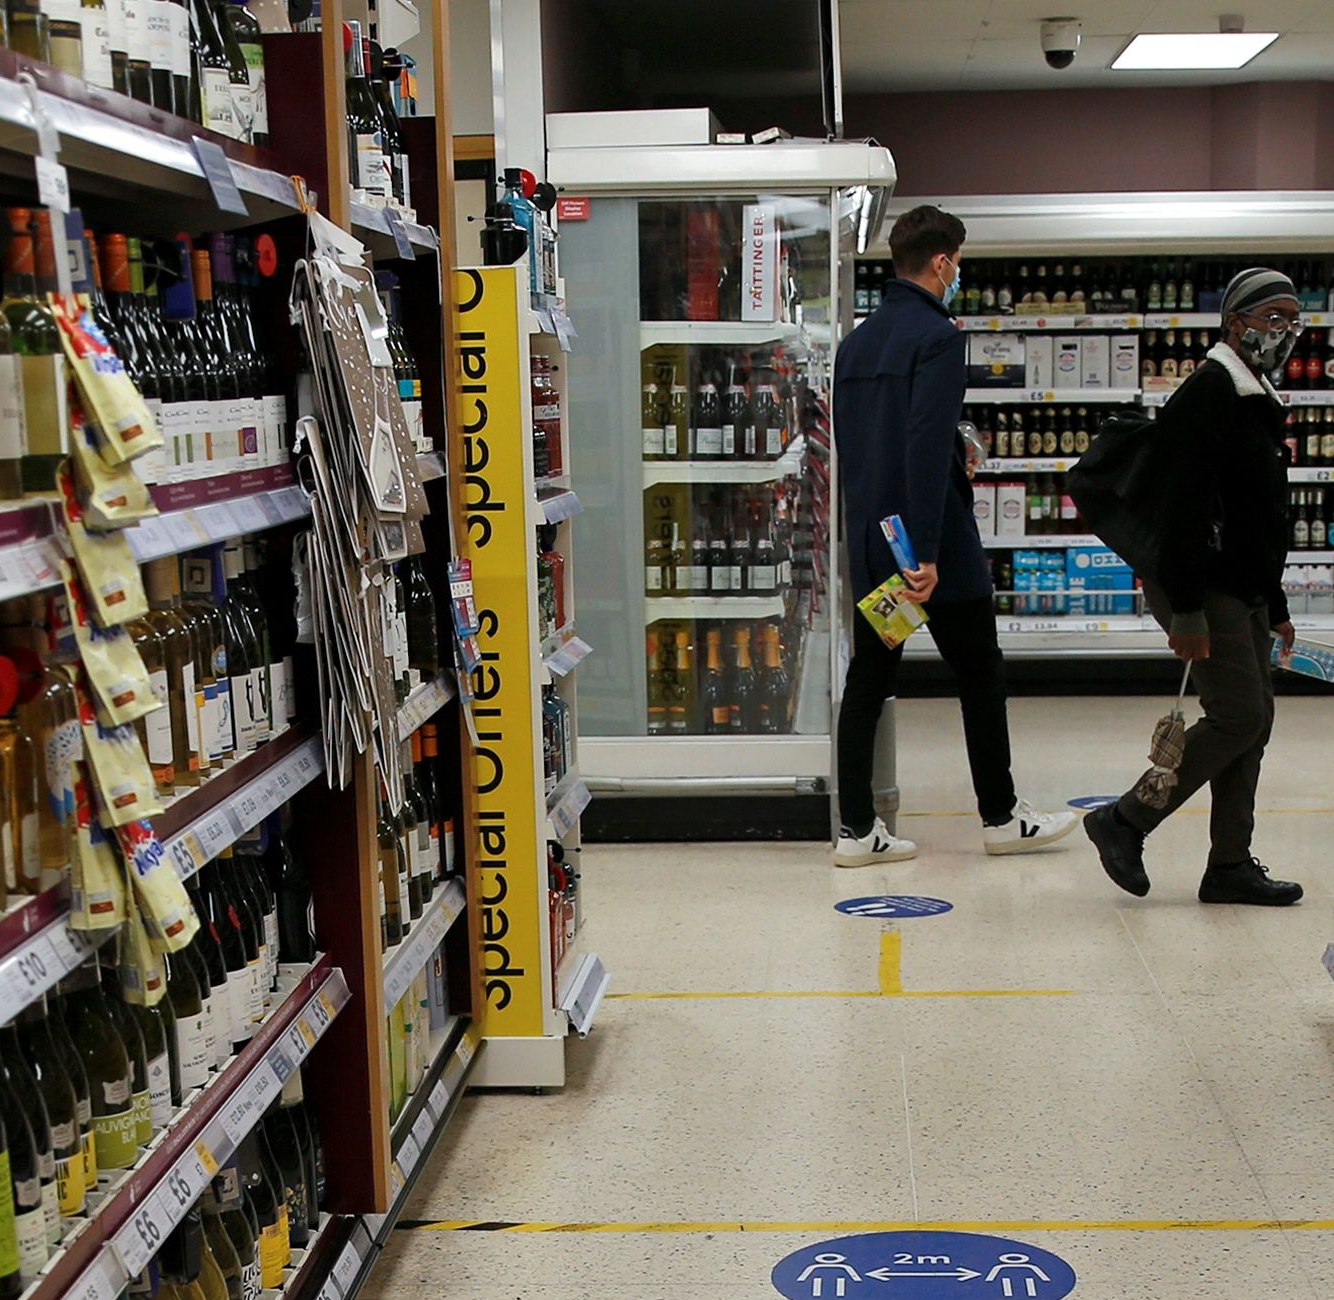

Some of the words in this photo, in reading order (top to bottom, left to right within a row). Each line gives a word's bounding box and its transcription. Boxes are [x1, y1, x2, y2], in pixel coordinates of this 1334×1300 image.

[751, 215, 765, 311] TAITTINGER
[1316, 471, 1330, 481] £2
[172, 839, 195, 876] £5
[17, 951, 47, 986] £10
[168, 1168, 192, 1206] £6
[134, 1209, 161, 1251] £6
[892, 1252, 953, 1268] 2m
